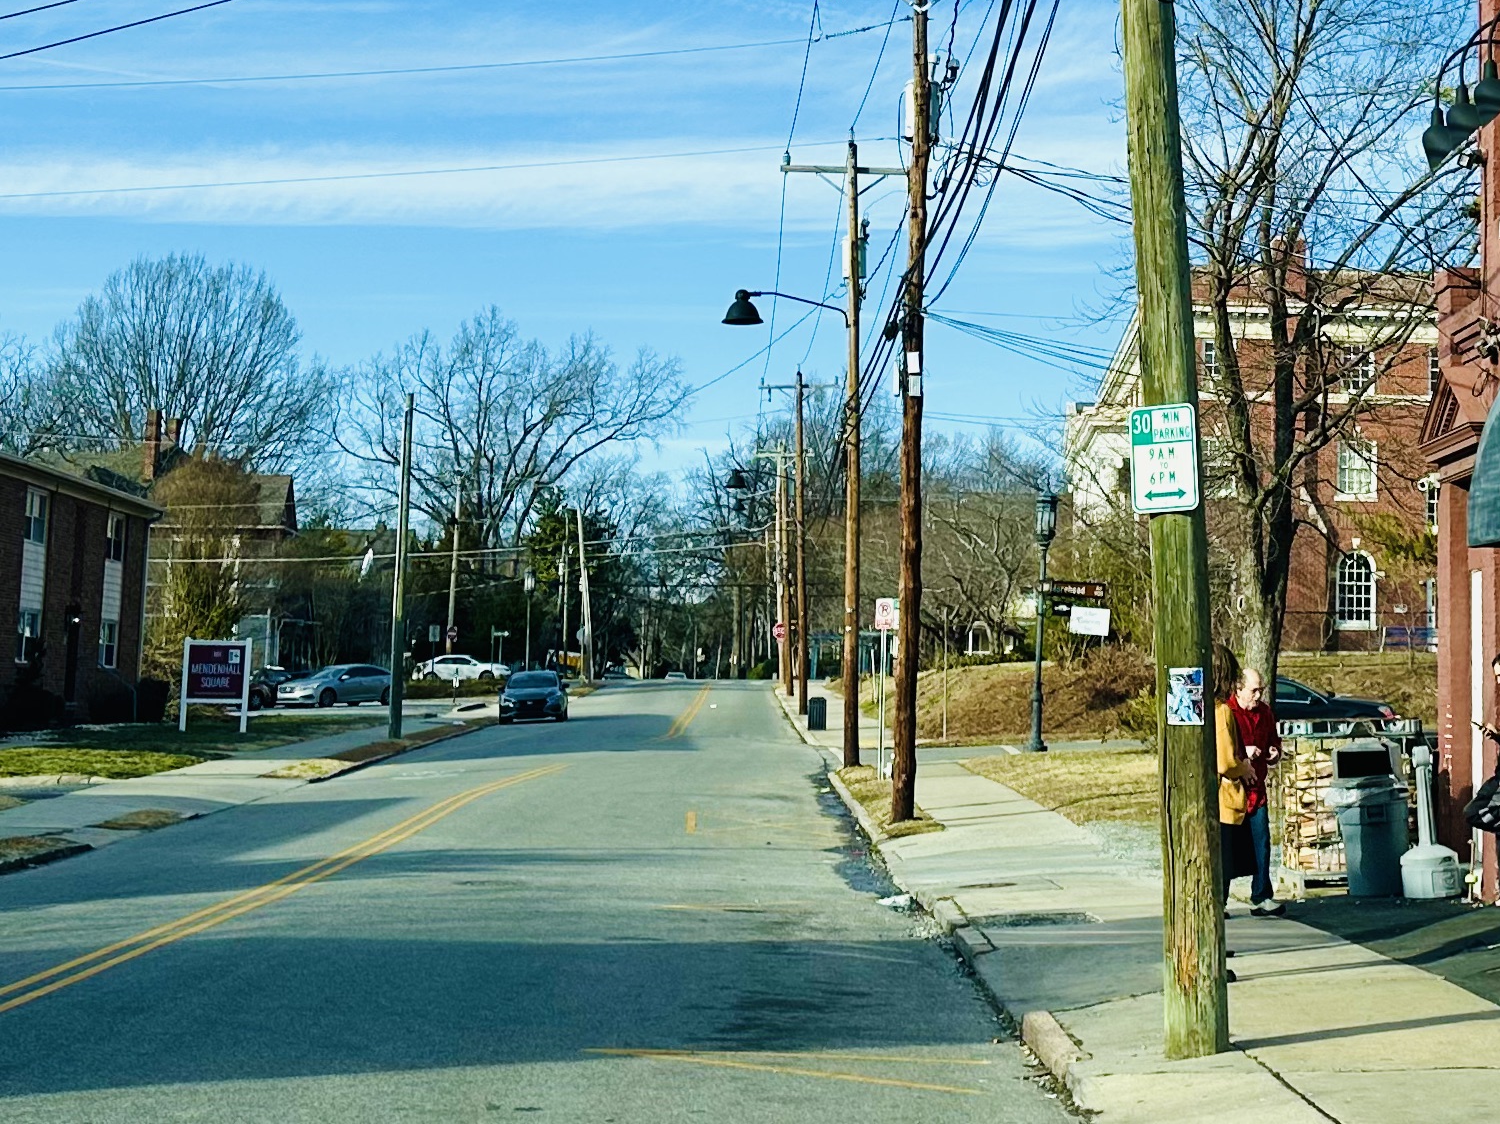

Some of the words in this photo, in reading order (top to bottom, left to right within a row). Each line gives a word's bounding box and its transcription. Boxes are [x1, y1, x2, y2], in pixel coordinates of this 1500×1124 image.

[1162, 410, 1180, 424] MIN
[1132, 413, 1151, 435] 30
[1153, 425, 1191, 440] PARKING
[1159, 461, 1169, 469] TO
[191, 663, 241, 674] MENDENHALL
[201, 677, 230, 688] SQUARE
